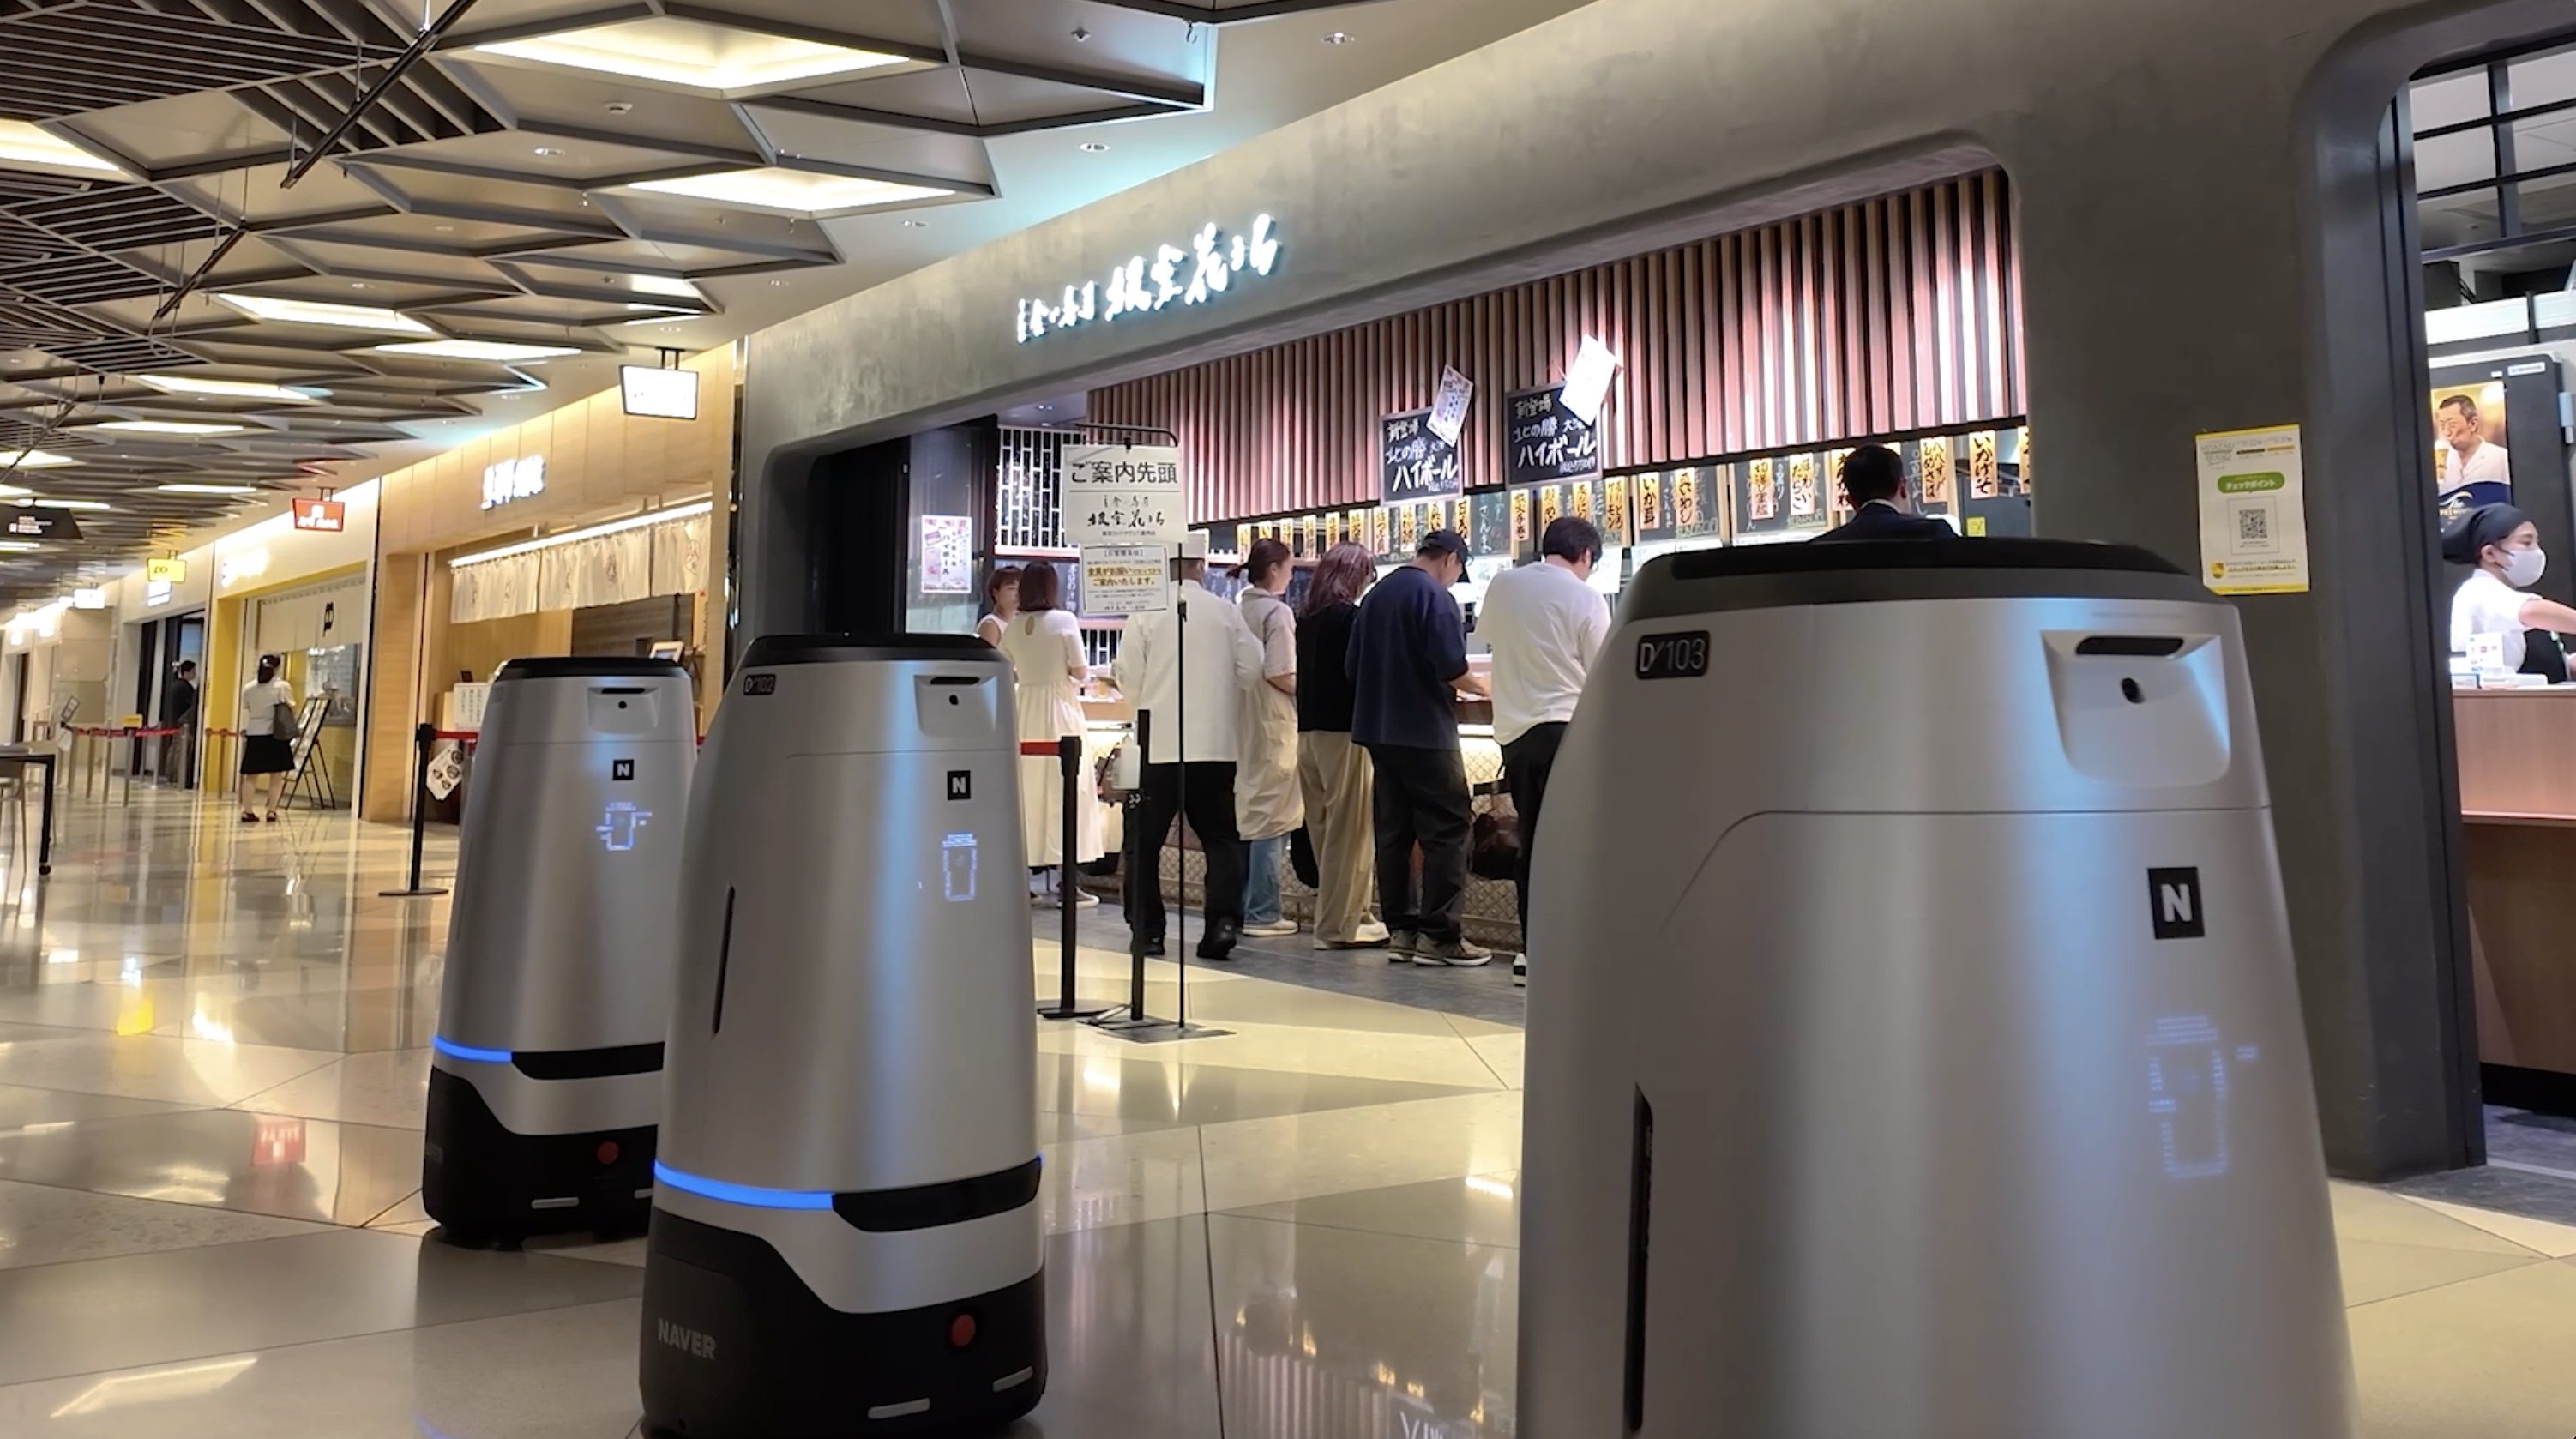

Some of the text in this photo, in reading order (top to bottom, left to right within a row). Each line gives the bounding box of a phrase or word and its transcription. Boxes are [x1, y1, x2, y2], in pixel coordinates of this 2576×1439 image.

[1514, 394, 1552, 420] 新登場
[1517, 430, 1597, 468] ハイボール
[1973, 437, 1994, 495] いかげそ
[1072, 461, 1177, 484] ご案内先頭
[1392, 454, 1459, 492] ハイボール
[2225, 479, 2276, 491] チェックポイント
[1639, 637, 1706, 673] D/103
[617, 763, 630, 777] N
[952, 777, 967, 794] N
[2161, 883, 2193, 923] N
[658, 1316, 717, 1361] NAVER
